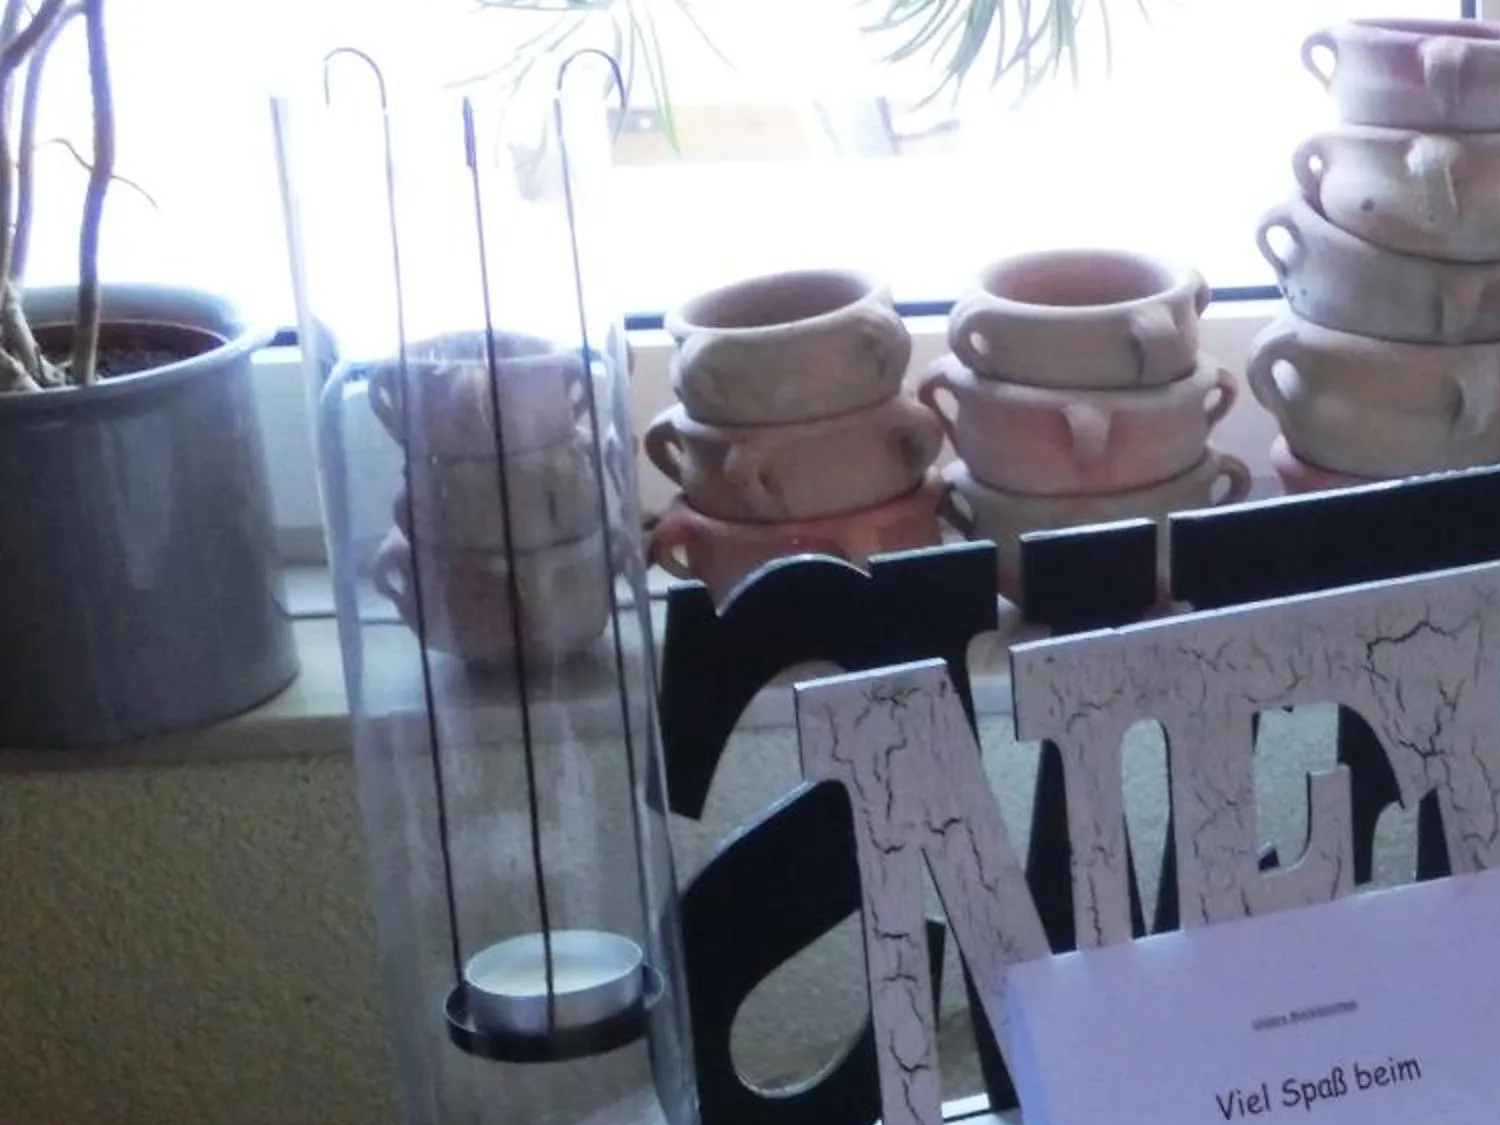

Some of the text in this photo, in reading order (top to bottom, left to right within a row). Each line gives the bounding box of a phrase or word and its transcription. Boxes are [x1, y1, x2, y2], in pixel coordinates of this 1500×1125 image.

[1215, 1056, 1422, 1121] Viel Spaß beim
